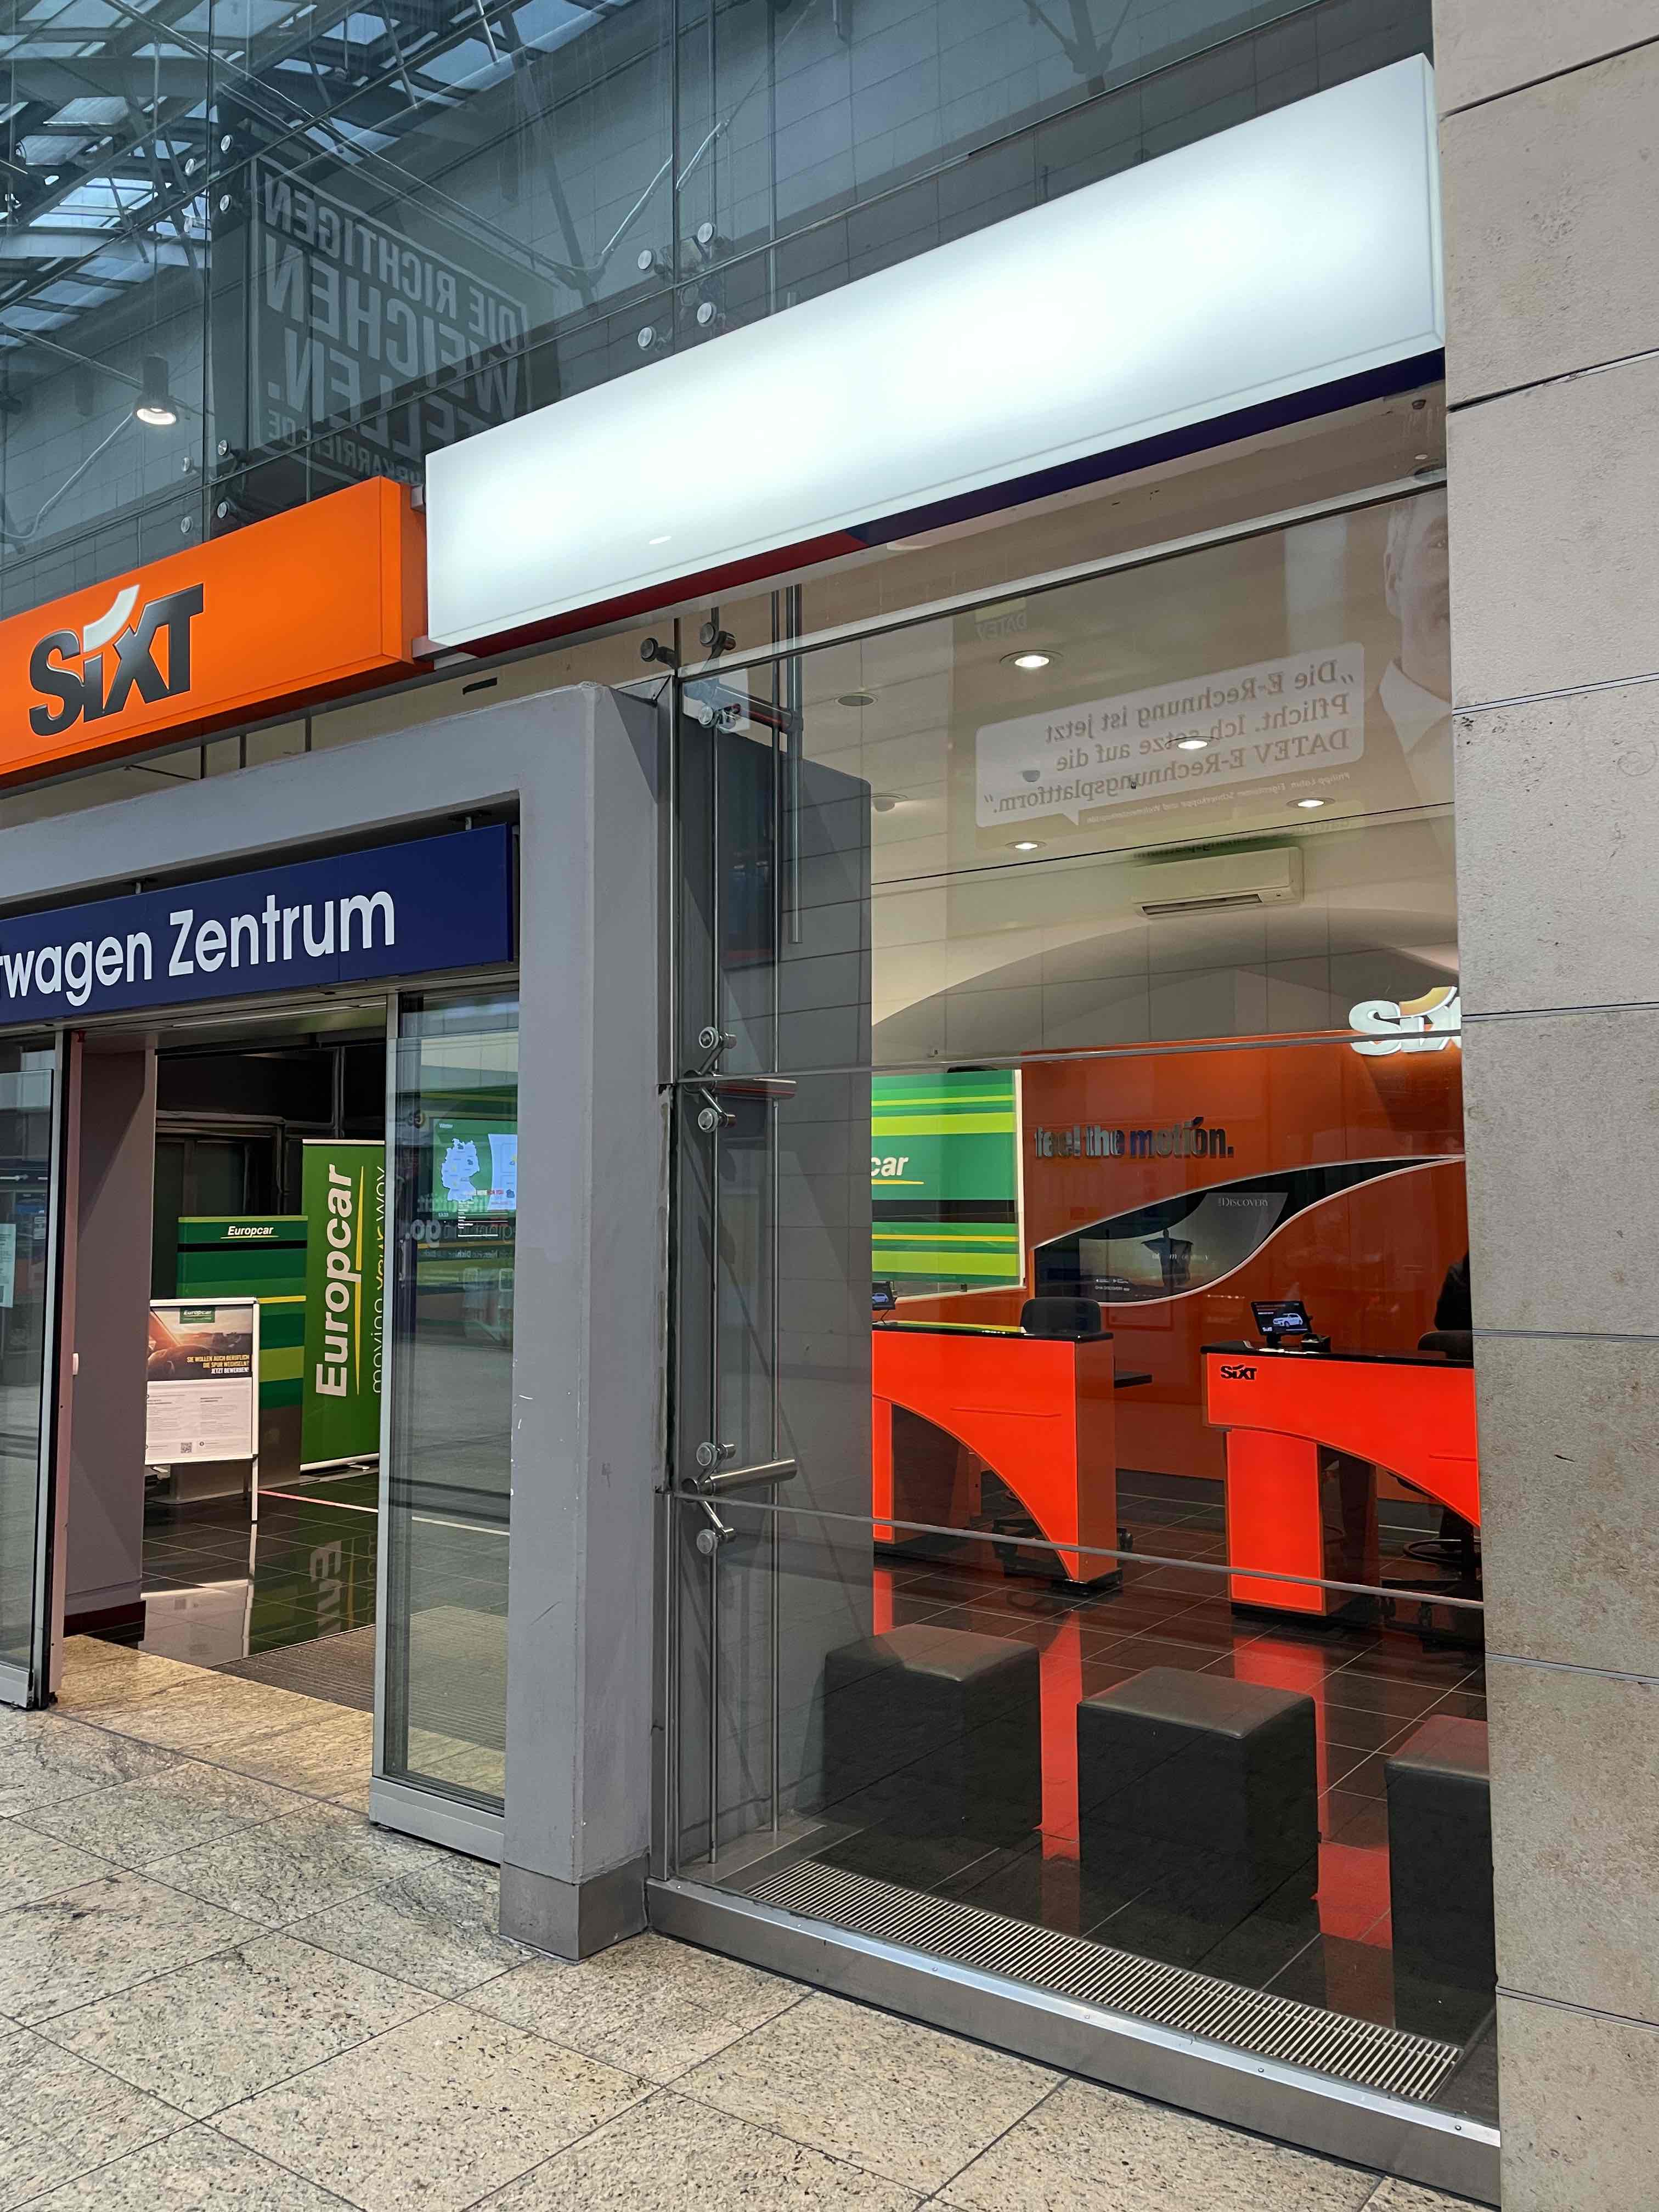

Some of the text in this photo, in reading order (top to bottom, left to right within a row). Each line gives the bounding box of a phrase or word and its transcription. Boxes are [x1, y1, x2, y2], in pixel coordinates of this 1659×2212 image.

[0, 890, 394, 1006] wagen Zentrum
[1034, 1116, 1234, 1159] feel the motion.
[228, 1226, 274, 1238] Europcar
[316, 1164, 362, 1397] Europcar
